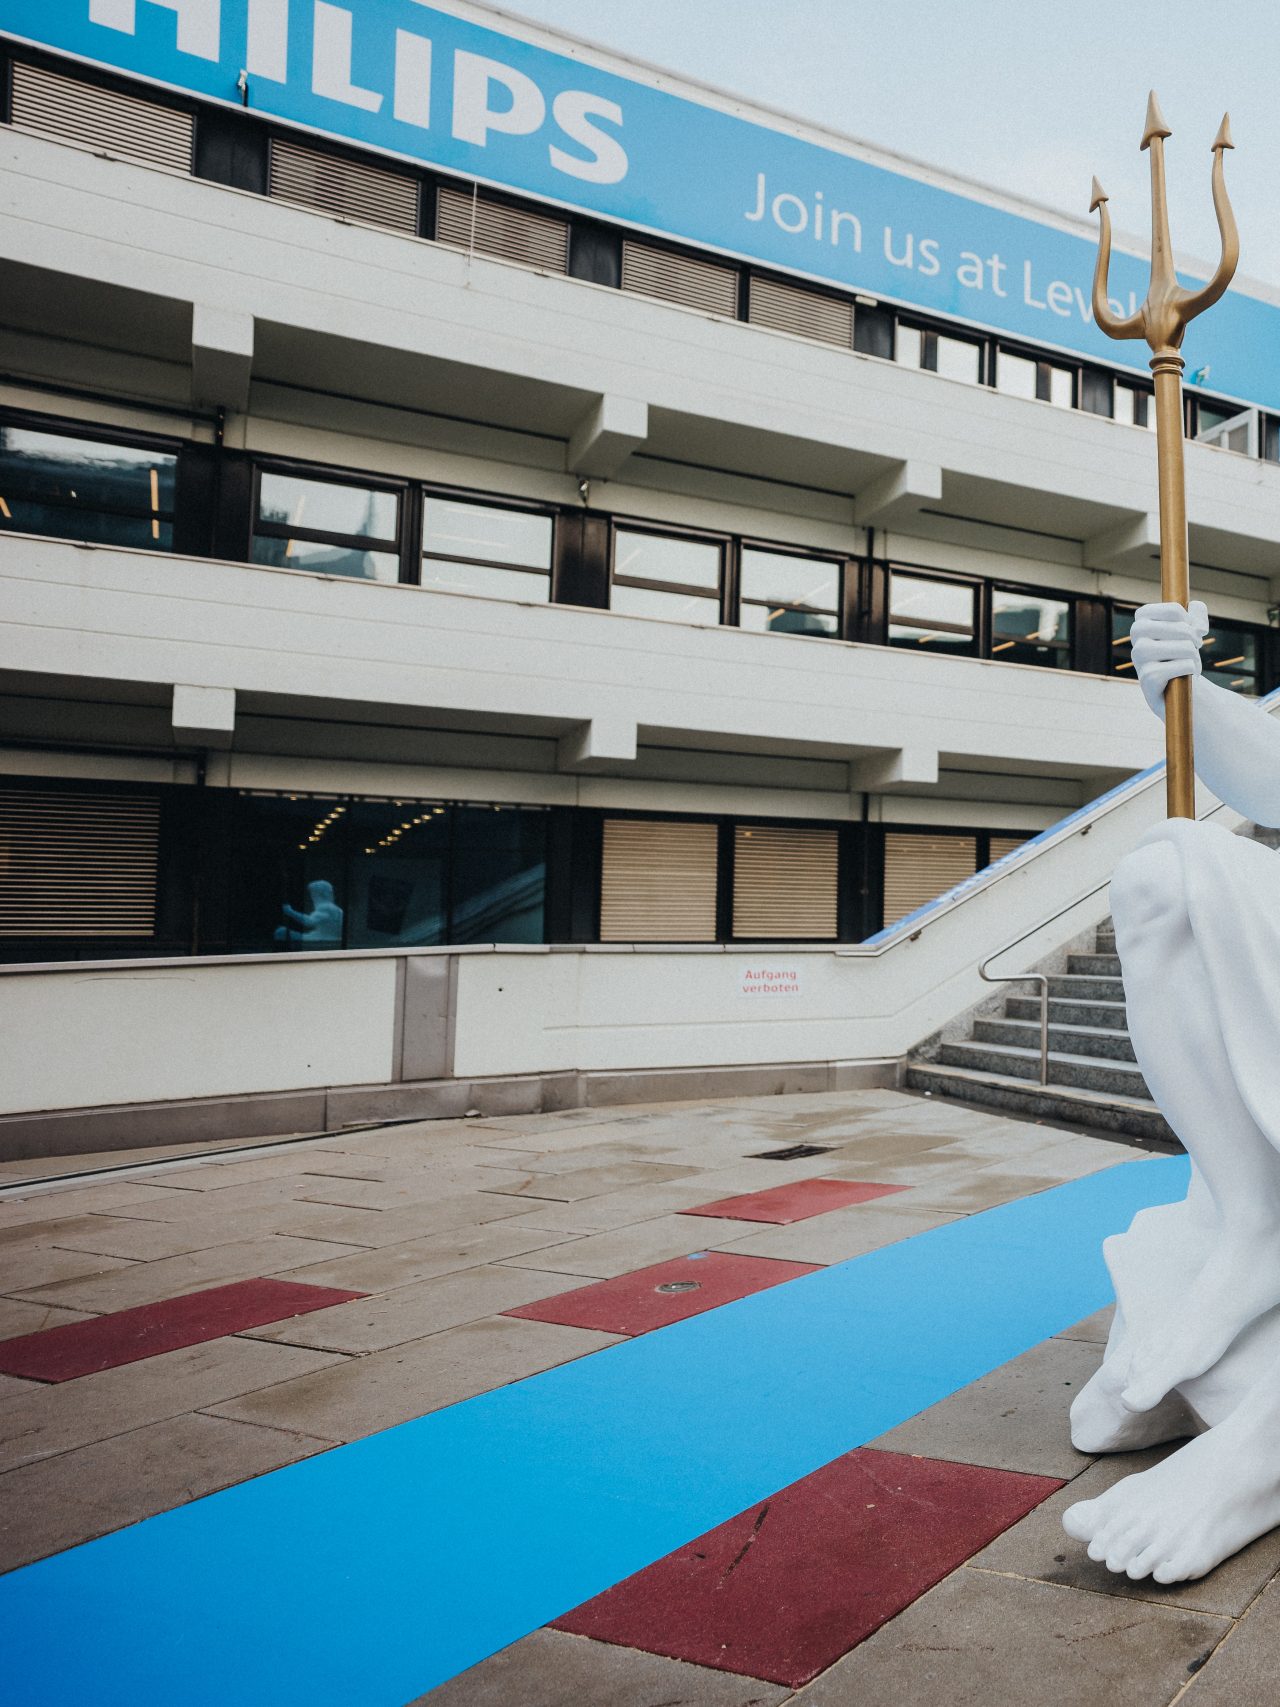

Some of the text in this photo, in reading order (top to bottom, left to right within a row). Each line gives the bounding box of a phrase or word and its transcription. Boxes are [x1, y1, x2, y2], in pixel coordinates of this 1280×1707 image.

[744, 172, 863, 253] Join
[883, 226, 941, 275] us
[956, 251, 1008, 297] at
[745, 969, 797, 981] Aufgang
[742, 983, 799, 993] verboten
